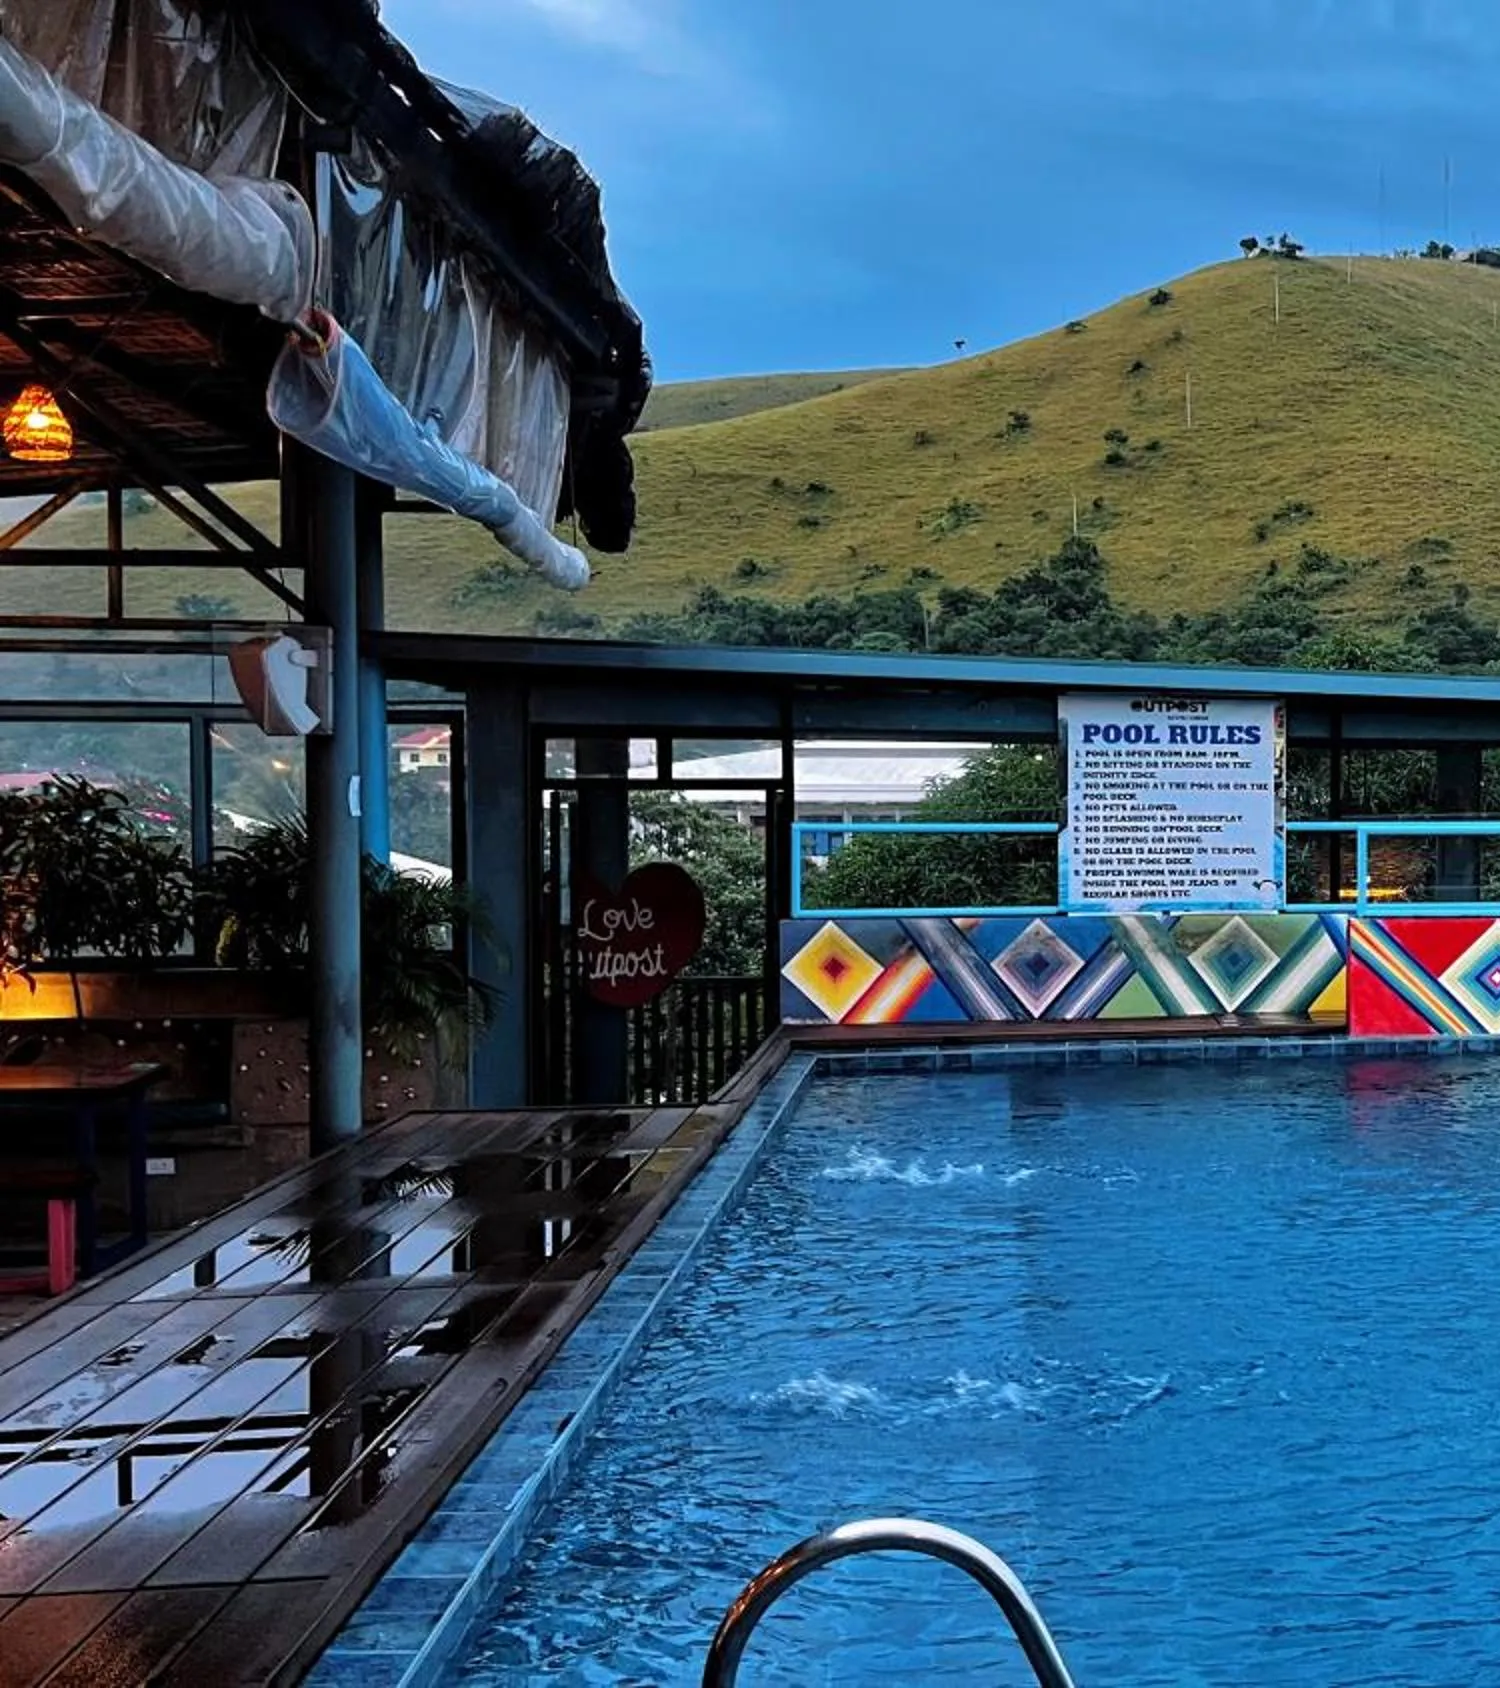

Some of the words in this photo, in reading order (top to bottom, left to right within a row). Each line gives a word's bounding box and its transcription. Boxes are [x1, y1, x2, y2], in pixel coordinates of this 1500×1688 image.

[1131, 700, 1209, 713] OUTPOST
[1083, 724, 1160, 745] POOL
[1168, 725, 1261, 745] RULES
[1085, 750, 1110, 758] POOL
[1125, 750, 1152, 758] OPEN
[1154, 750, 1182, 758] FROM
[1103, 761, 1143, 769] SITTING
[1161, 761, 1212, 769] STANDING
[1233, 761, 1252, 769] THE
[1103, 782, 1150, 790] SMOKING
[1168, 782, 1187, 790] THE
[1190, 782, 1214, 790] POOL
[1250, 782, 1269, 790] THE
[1102, 847, 1133, 855] GLASS
[1147, 847, 1195, 855] ALLOWED
[1211, 847, 1230, 855] THE
[1232, 847, 1256, 855] POOL
[1085, 869, 1124, 877] PROPER
[1167, 869, 1197, 877] WARE
[1211, 869, 1259, 877] REQUIRED
[1083, 890, 1128, 898] REGULAR
[1131, 890, 1168, 898] SHORTS
[577, 897, 656, 941] Love
